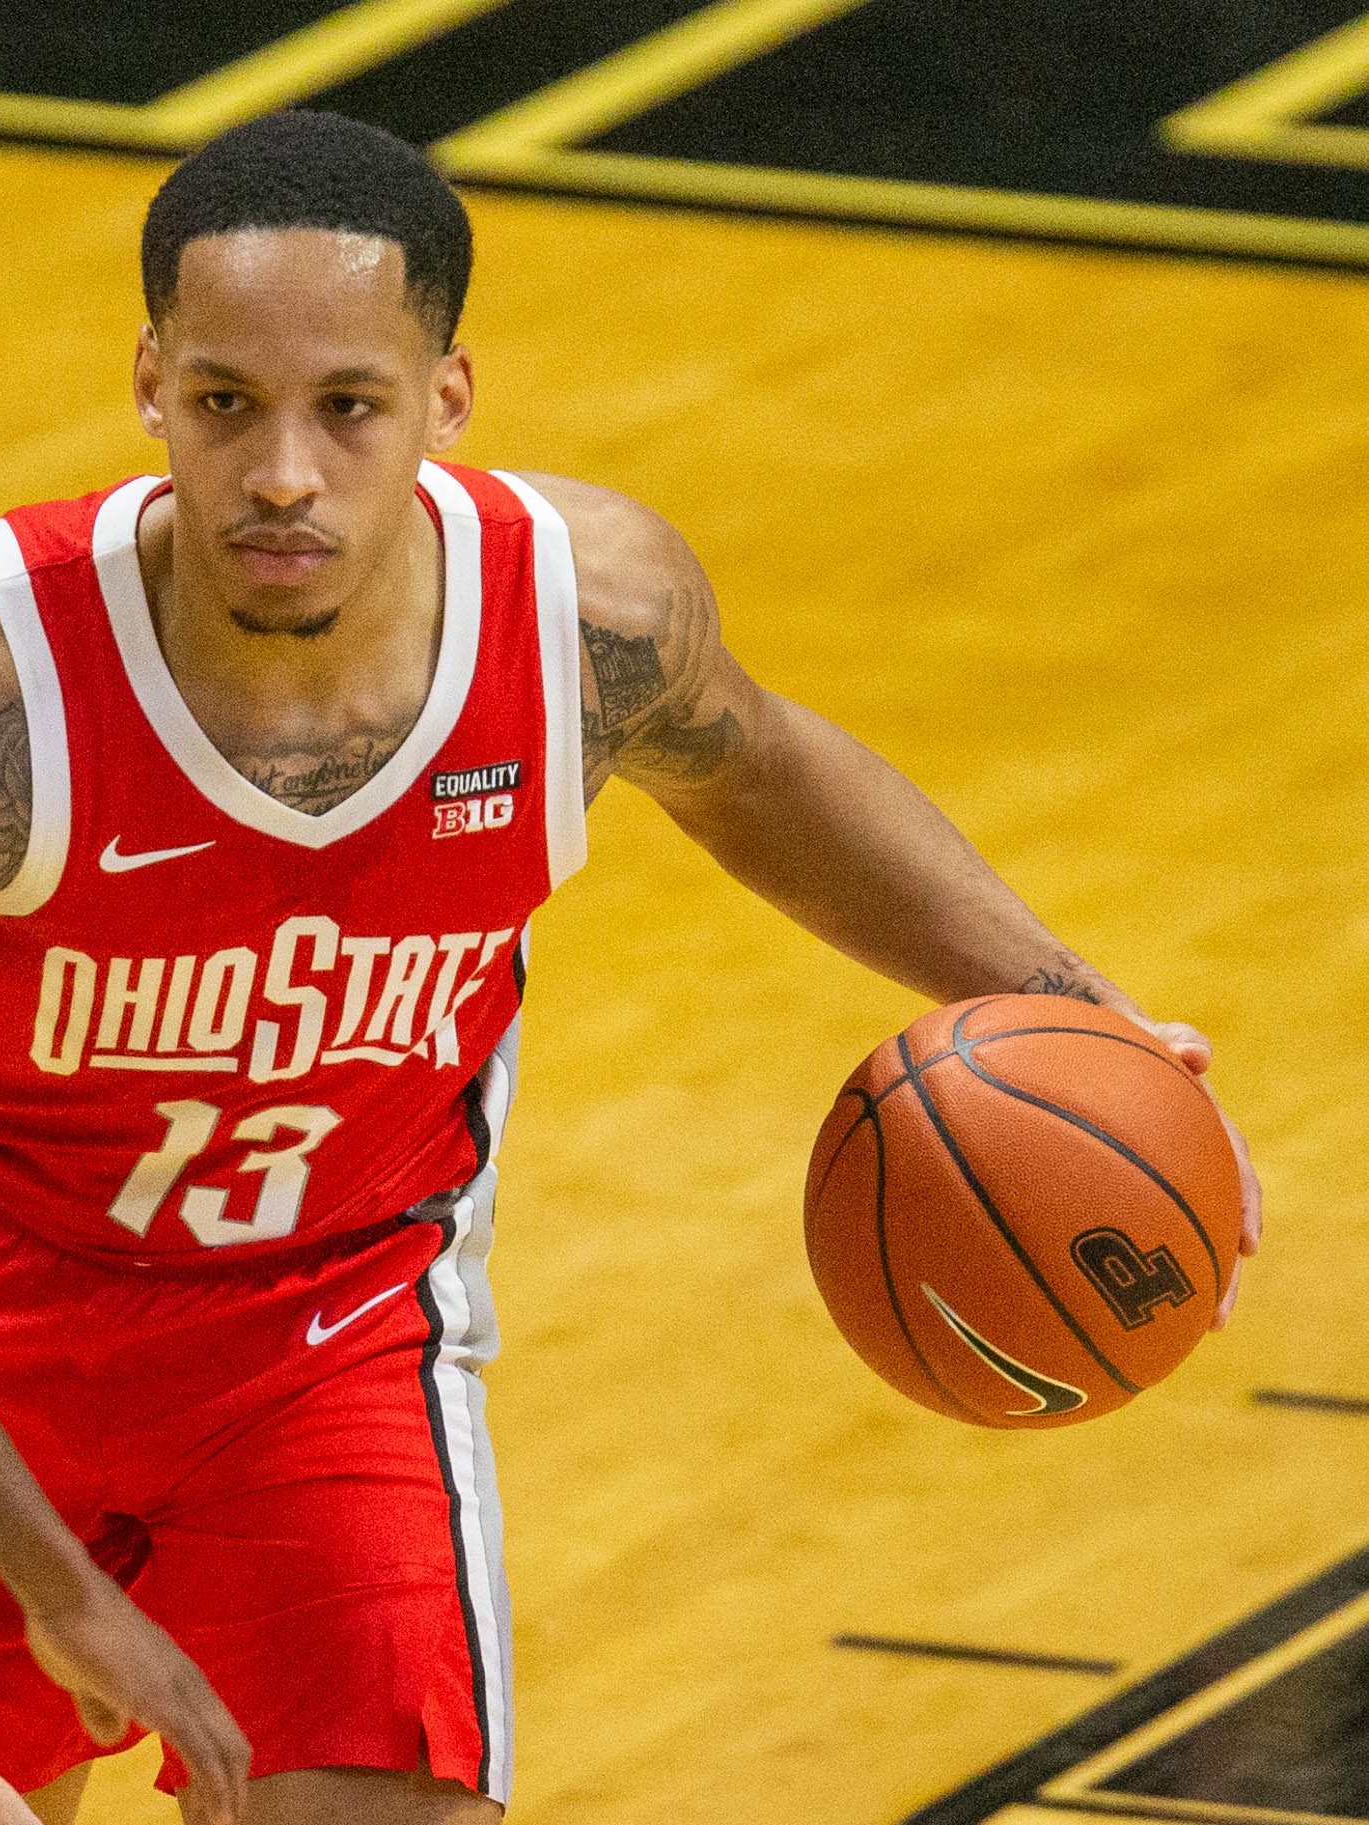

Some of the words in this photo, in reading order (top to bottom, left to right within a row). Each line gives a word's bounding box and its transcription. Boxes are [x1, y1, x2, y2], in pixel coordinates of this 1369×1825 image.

[435, 763, 519, 797] EQUALITY
[30, 945, 258, 1076] OHIO
[107, 1099, 343, 1249] 13
